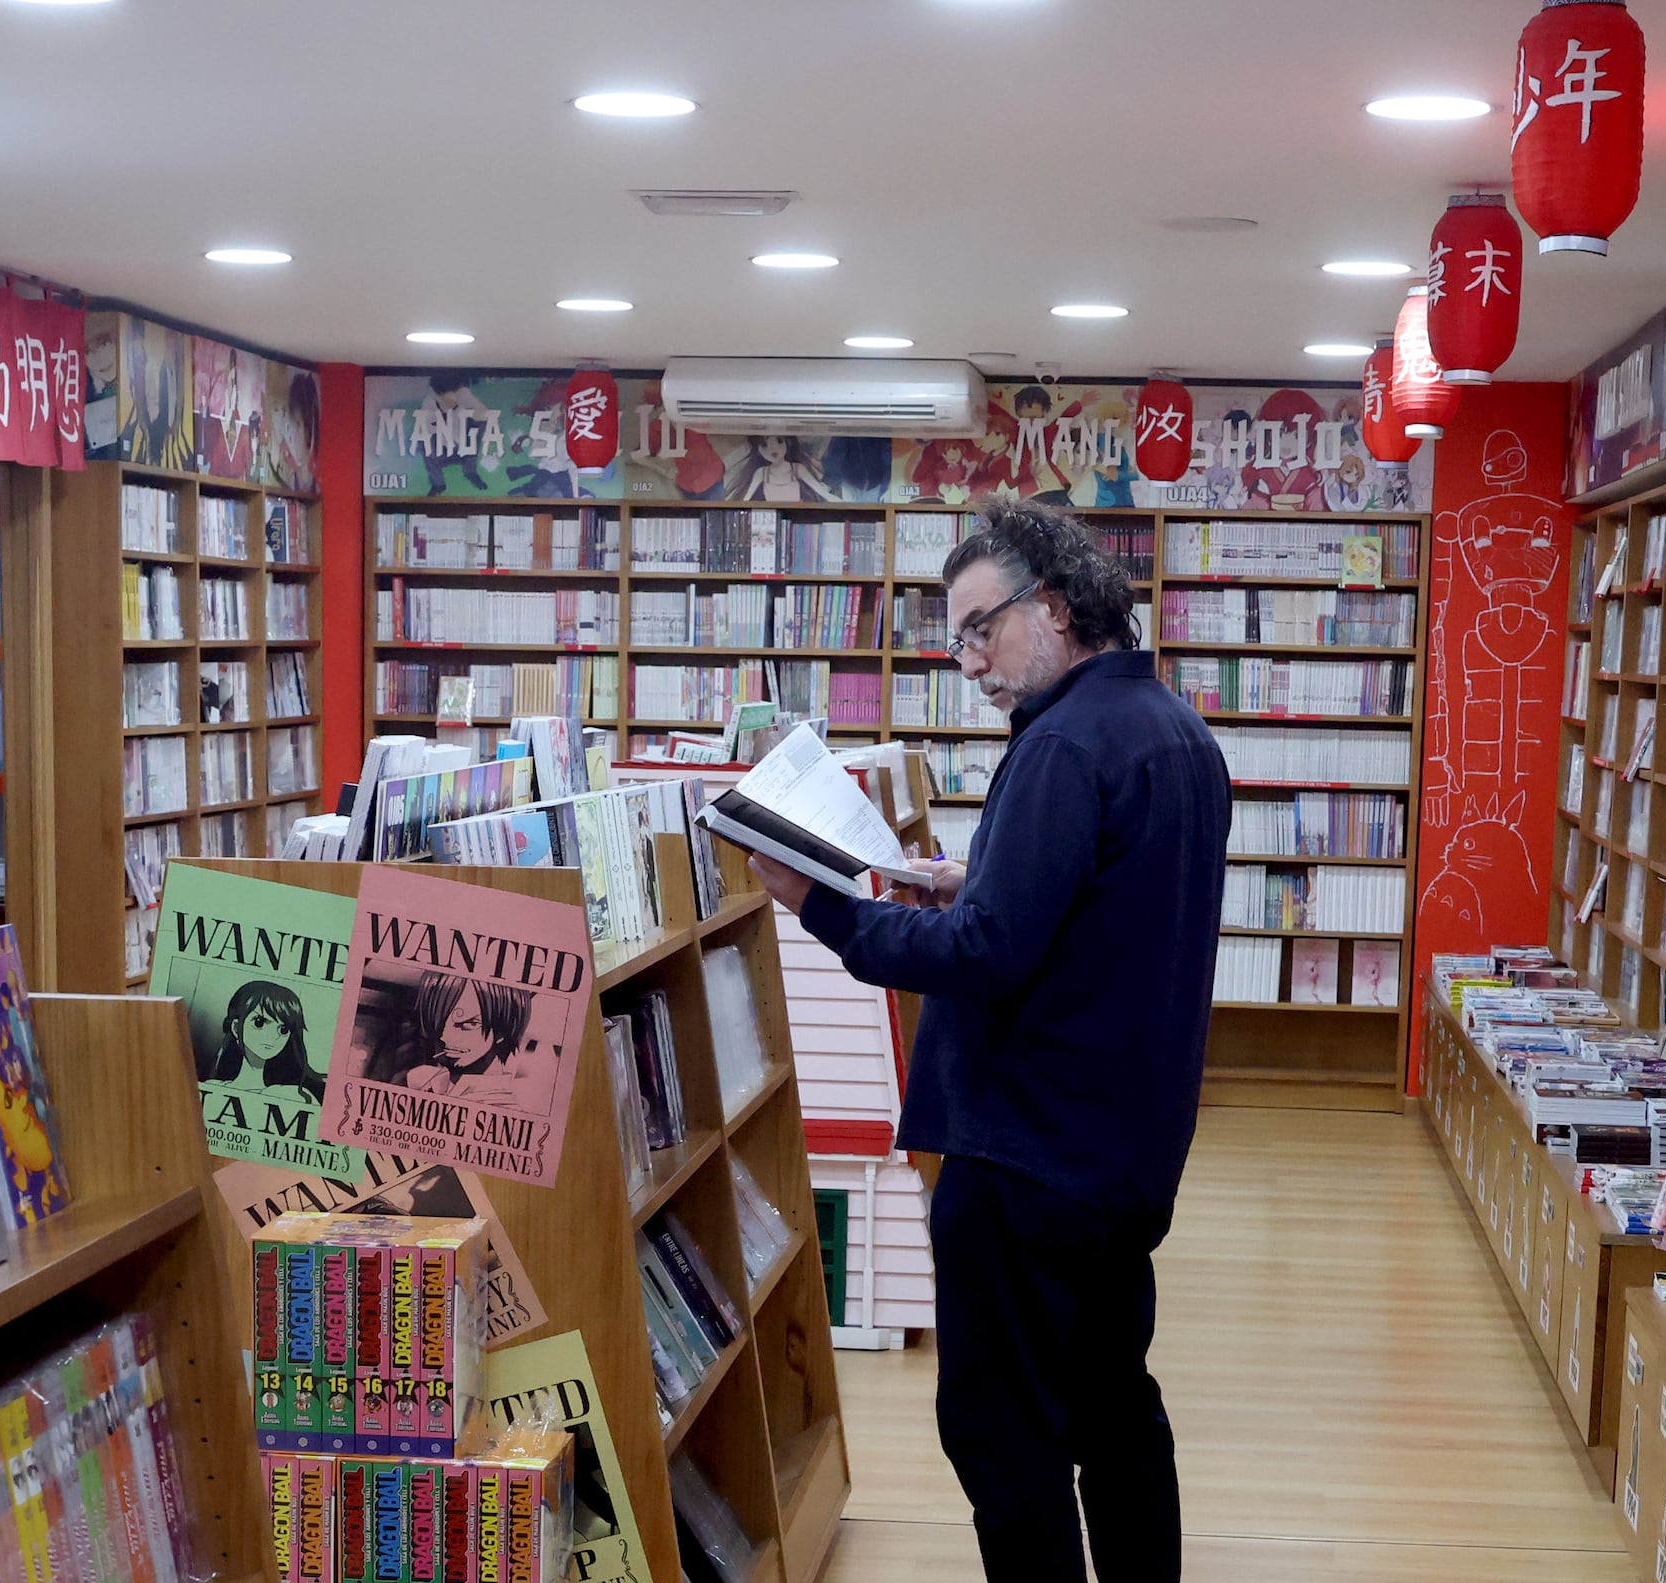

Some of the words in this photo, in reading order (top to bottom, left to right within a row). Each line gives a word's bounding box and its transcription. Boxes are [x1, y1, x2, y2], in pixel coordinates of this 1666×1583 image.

[375, 407, 505, 458] MANGA
[567, 387, 608, 441] 愛
[1015, 416, 1123, 468] MANG
[1190, 413, 1345, 470] SHOJO
[369, 472, 408, 490] OJA1
[172, 910, 349, 984] WANTE
[366, 911, 585, 994] WANTED
[358, 1085, 469, 1141] VINSMOKE
[475, 1111, 535, 1152] SANJI
[369, 1124, 447, 1150] 330.000.000
[261, 1138, 340, 1173] MARINE
[453, 1142, 534, 1177] MARINE
[662, 1231, 678, 1257] ENTRE
[291, 1249, 314, 1290] BALL
[327, 1251, 347, 1292] BALL
[394, 1253, 414, 1295] BALL
[425, 1255, 446, 1298] BALL
[291, 1292, 314, 1362] DRAGON
[326, 1294, 347, 1363] DRAGON
[394, 1297, 414, 1365] DRAGON
[424, 1299, 446, 1367] DRAGON
[260, 1373, 281, 1390] 13
[293, 1375, 314, 1391] 14
[328, 1377, 348, 1393] 15
[362, 1378, 383, 1394] 16
[395, 1380, 415, 1396] 17
[426, 1381, 447, 1397] 18
[304, 1467, 324, 1507] BALL
[379, 1468, 401, 1509] BALL
[414, 1470, 435, 1511] BALL
[481, 1472, 499, 1516] BALL
[303, 1509, 324, 1577] DRAGON
[378, 1510, 401, 1578] DRAGON
[413, 1512, 434, 1580] DRAGON
[480, 1518, 499, 1583] DRAGON
